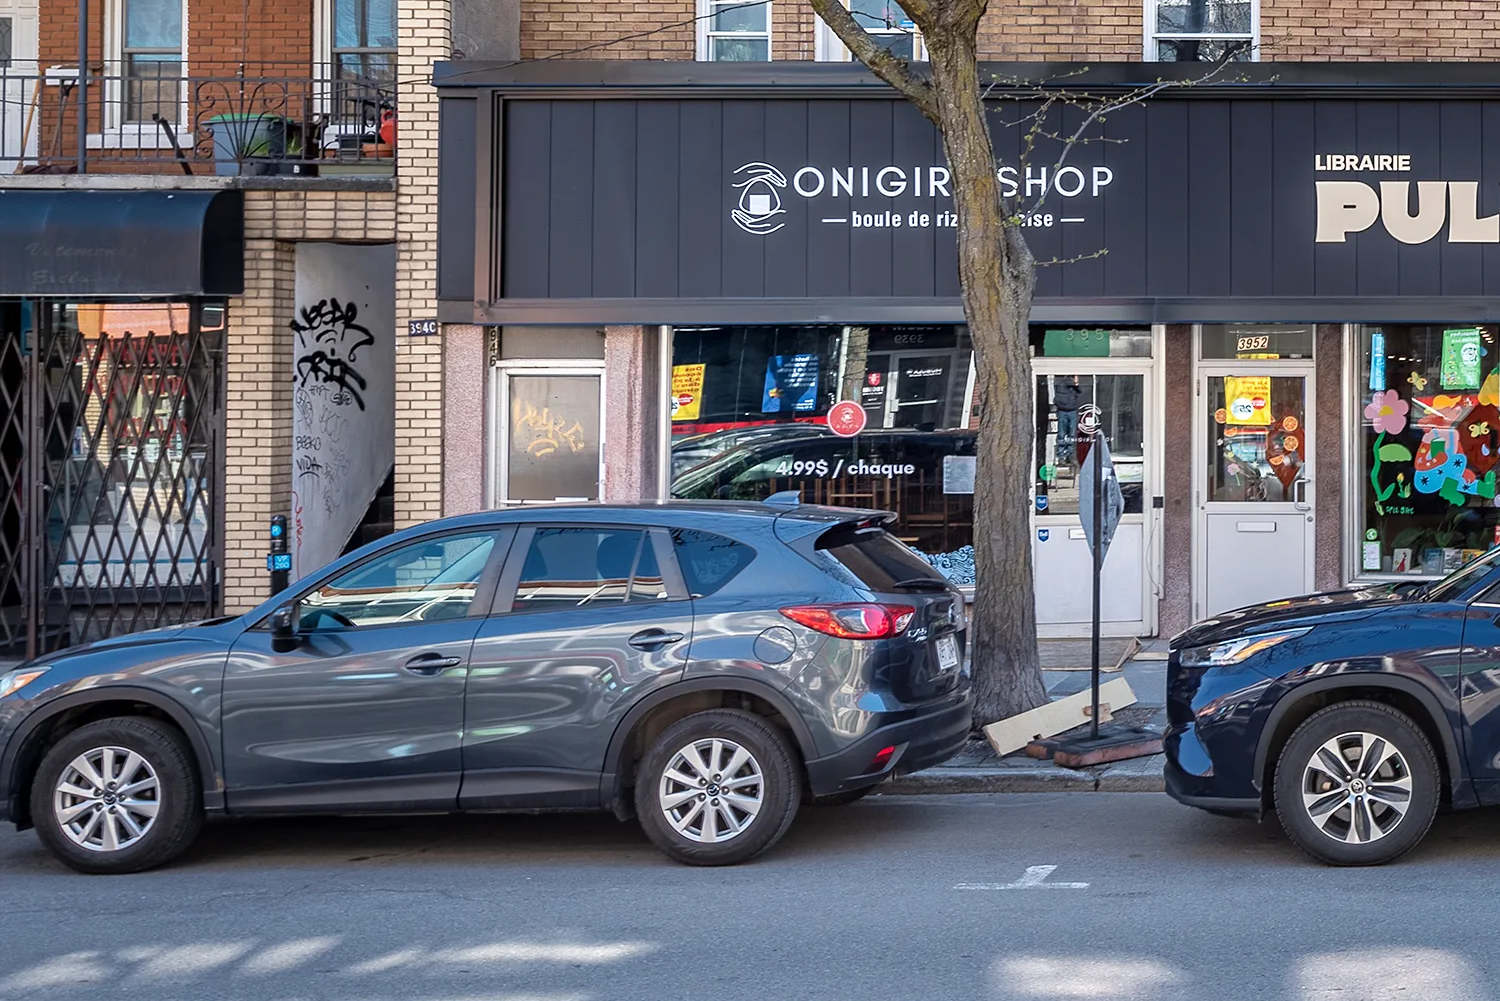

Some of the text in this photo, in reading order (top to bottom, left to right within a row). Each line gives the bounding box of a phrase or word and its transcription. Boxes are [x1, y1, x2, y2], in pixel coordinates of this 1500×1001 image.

[1314, 154, 1411, 171] LIBRAIRIE
[792, 165, 1114, 198] ONIGIR SHOP
[852, 210, 958, 228] boule de riz
[1064, 328, 1120, 341] 3950
[1238, 336, 1269, 350] 3952
[489, 325, 498, 367] 946
[774, 460, 829, 478] 4.99$
[848, 460, 916, 481] chaque
